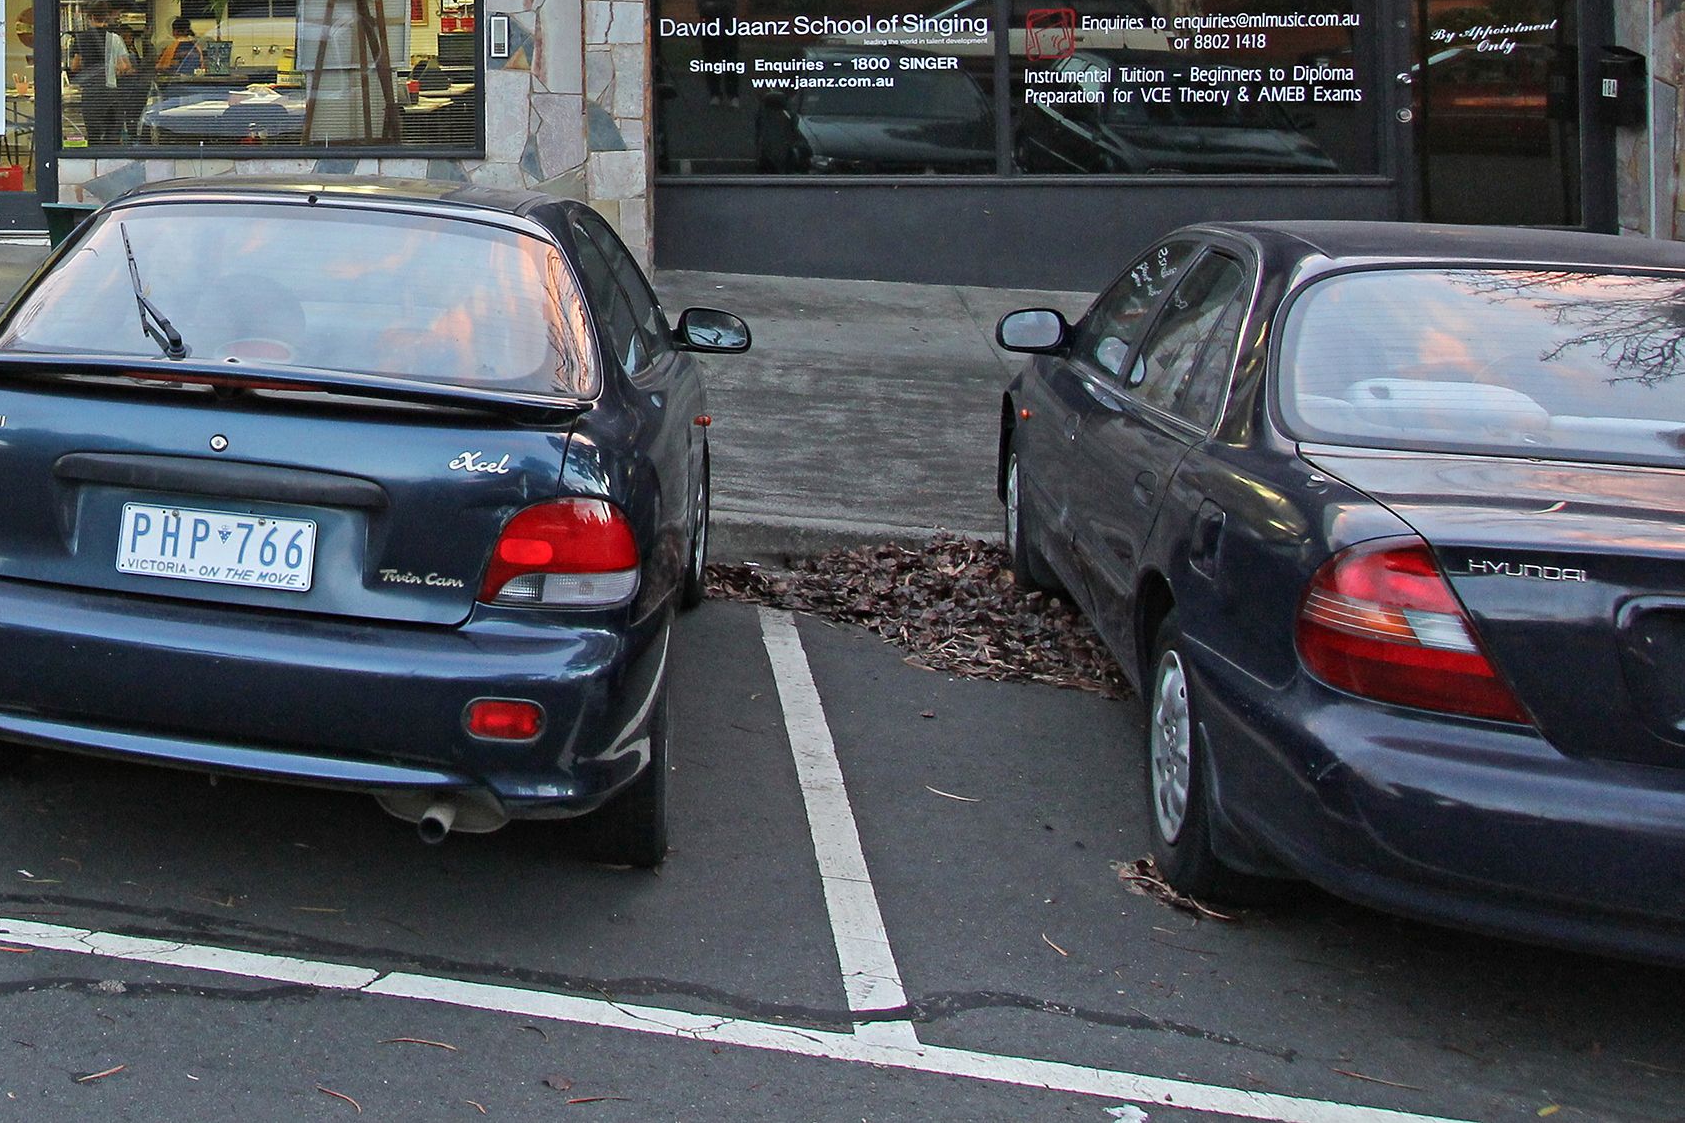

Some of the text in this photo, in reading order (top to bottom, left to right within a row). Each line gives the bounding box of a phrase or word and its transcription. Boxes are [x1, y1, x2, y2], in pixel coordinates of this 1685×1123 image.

[660, 13, 988, 37] David Jaanz School of Singing
[1082, 13, 1360, 34] Enquiries to enquiries@mlmusic.com.au
[1430, 19, 1558, 43] By Appointment
[1174, 34, 1266, 50] or 8802 1418
[1476, 38, 1516, 55] Only
[689, 59, 746, 74] Singing
[754, 58, 824, 73] Enquiries
[850, 57, 890, 71] 1800
[899, 57, 959, 71] SINGER
[751, 76, 895, 90] www.jaanz.com.au
[1024, 68, 1111, 84] Instrumental
[1118, 67, 1165, 83] Tuition
[1190, 67, 1262, 86] Beginners
[1269, 68, 1285, 82] to
[1293, 66, 1354, 85] Diploma
[1025, 86, 1362, 108] Preparation for VCE Theory & AMEB Exams
[130, 512, 305, 570] PHP 766
[198, 566, 220, 578] ON
[226, 567, 255, 582] THE
[256, 571, 300, 586] MOVE
[379, 568, 465, 588] Twin Cam
[1468, 558, 1587, 583] HYUNDAI
